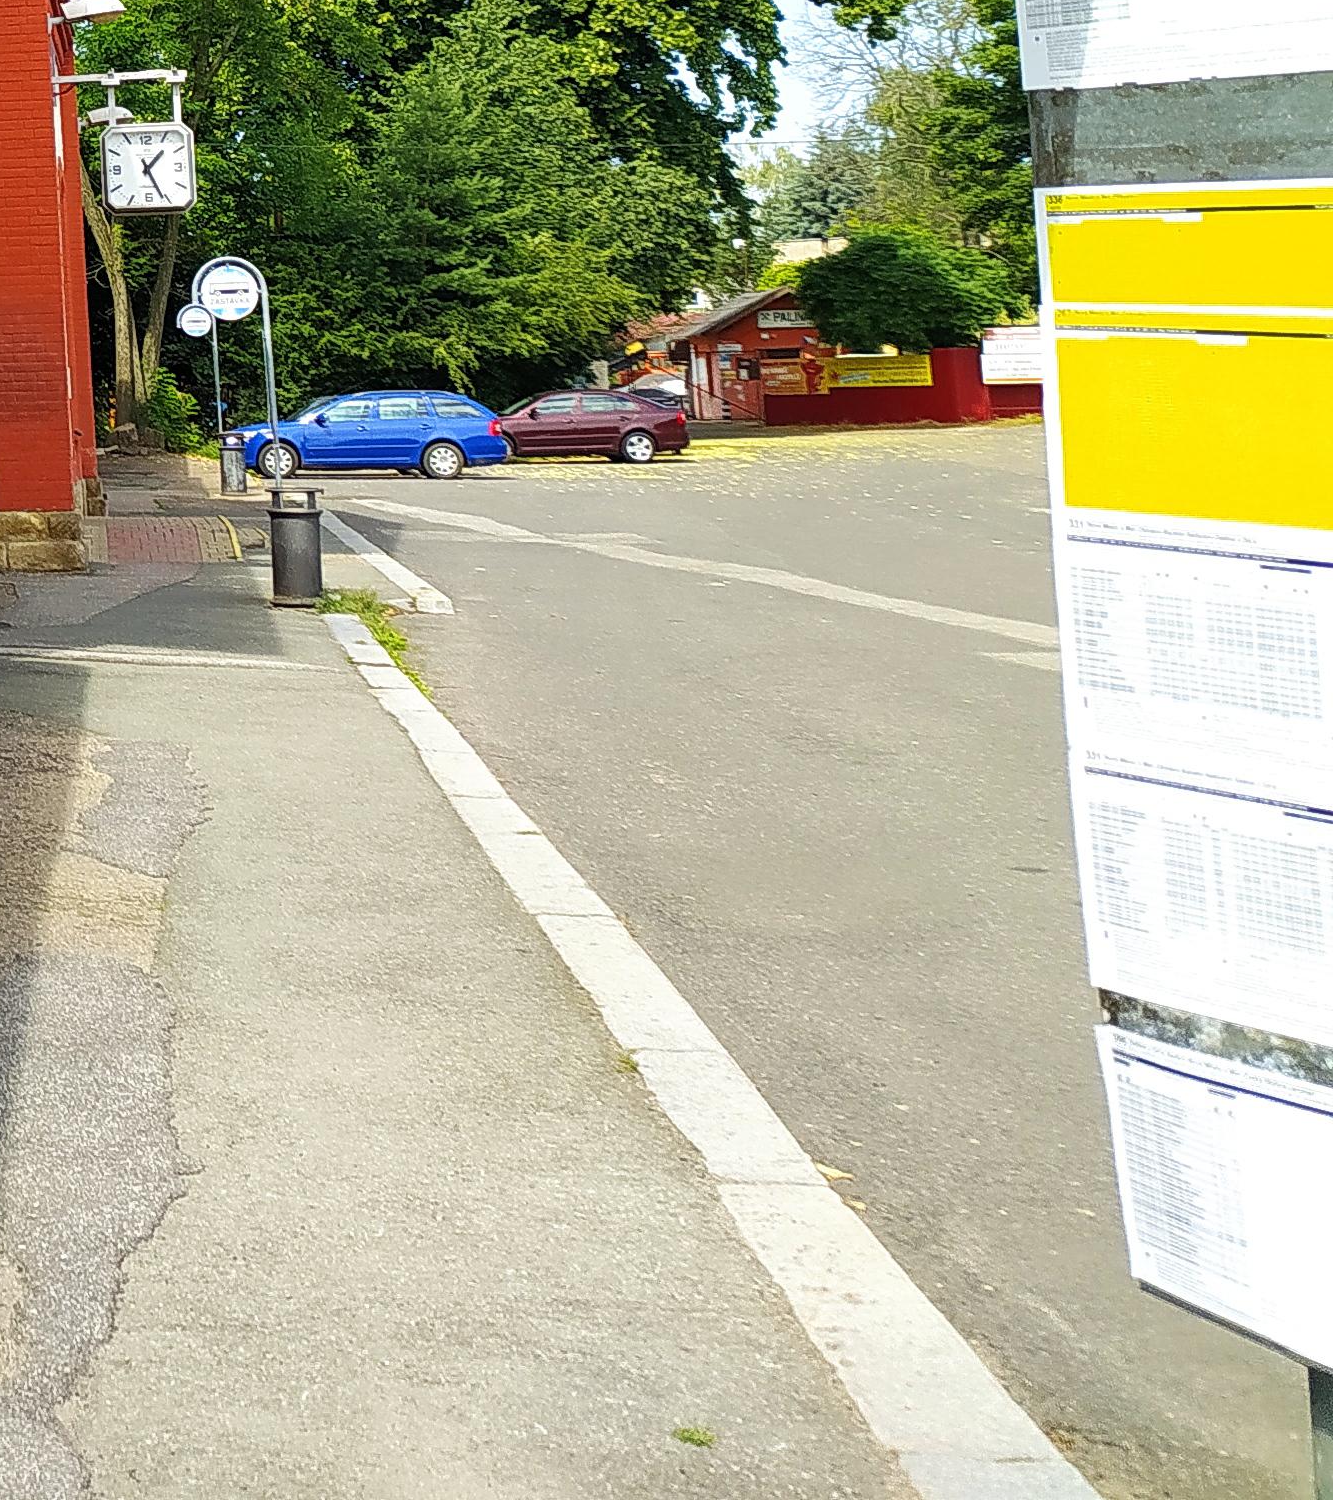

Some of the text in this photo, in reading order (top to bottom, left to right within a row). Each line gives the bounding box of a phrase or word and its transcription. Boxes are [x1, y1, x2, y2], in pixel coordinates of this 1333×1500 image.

[139, 136, 153, 145] 12
[113, 162, 183, 175] 9 3
[145, 192, 153, 202] 6
